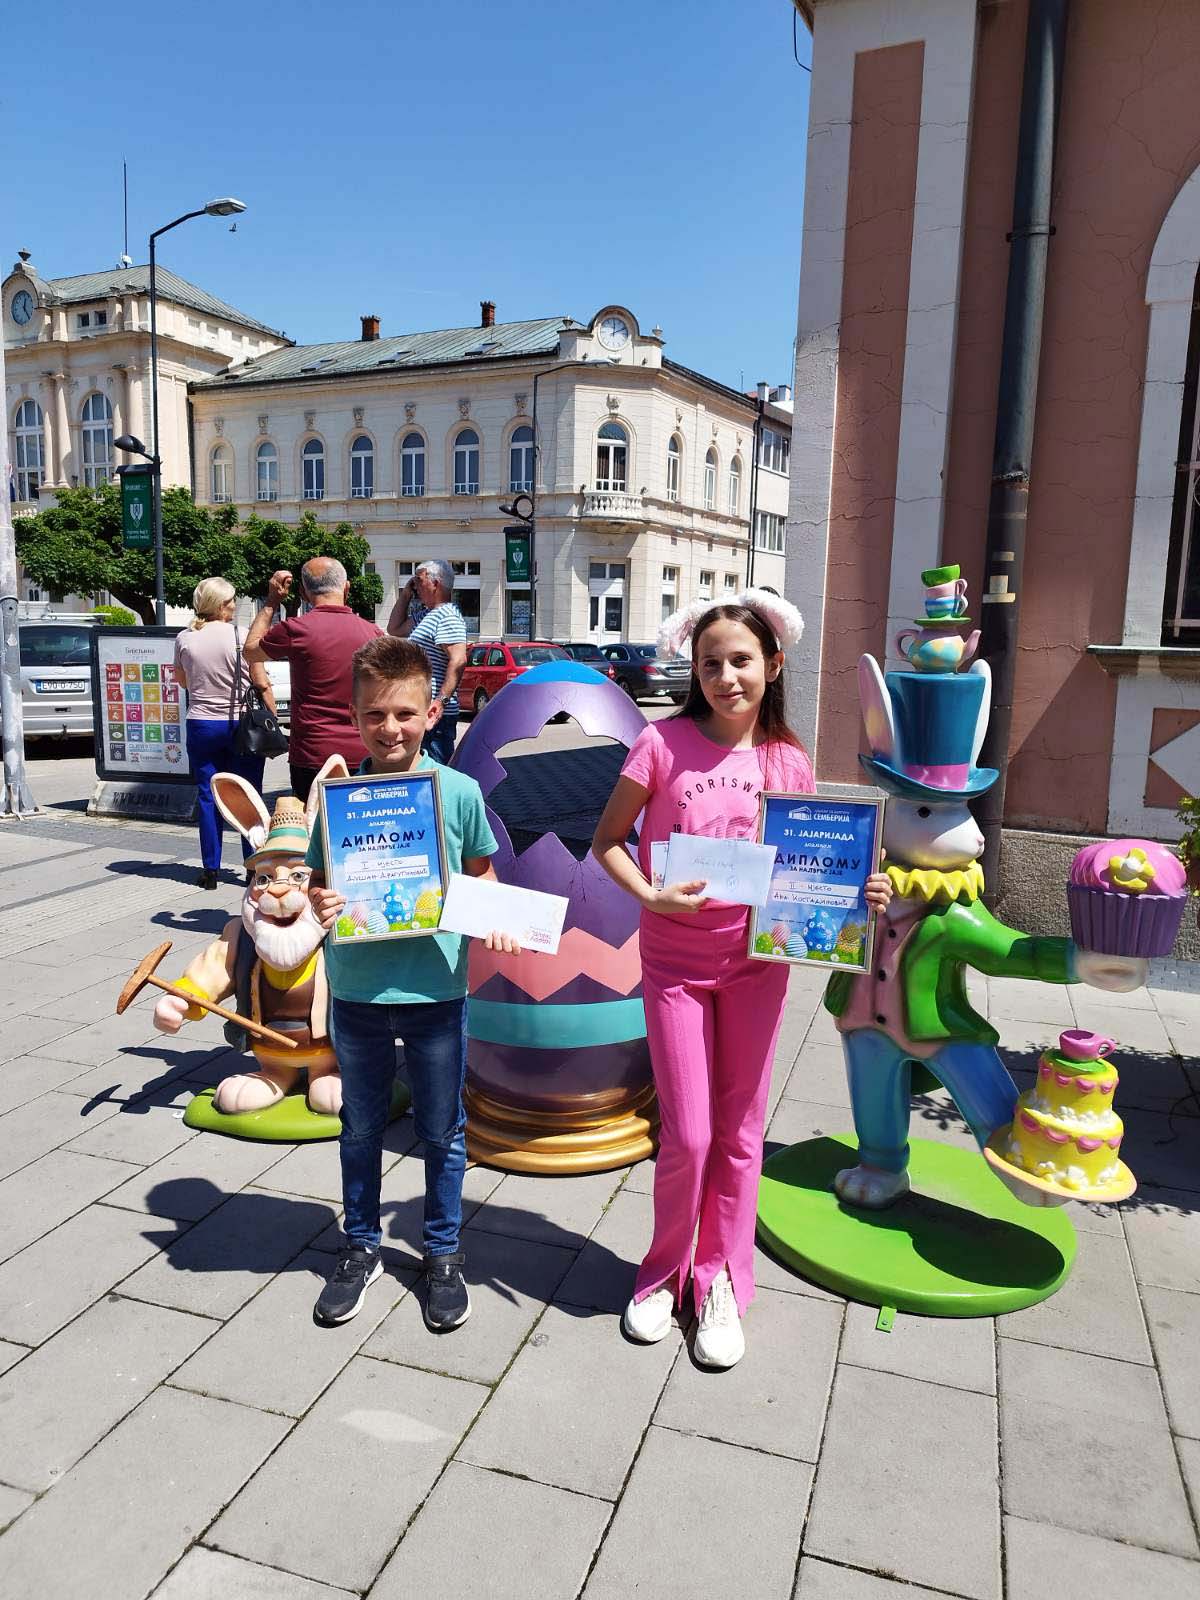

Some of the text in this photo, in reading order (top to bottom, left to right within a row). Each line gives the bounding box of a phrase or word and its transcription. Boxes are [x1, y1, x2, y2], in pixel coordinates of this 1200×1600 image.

[373, 790, 409, 800] СЕМБЕРИЈА
[346, 806, 416, 820] 31. ЈАЈАРИЈАДА
[813, 814, 850, 823] СЕМБЕРИЈА
[341, 830, 426, 849] ДИПЛОМУ
[784, 828, 855, 841] 31. ЈАЈАРИЈАДА
[774, 853, 861, 870] ДИПЛОМУ
